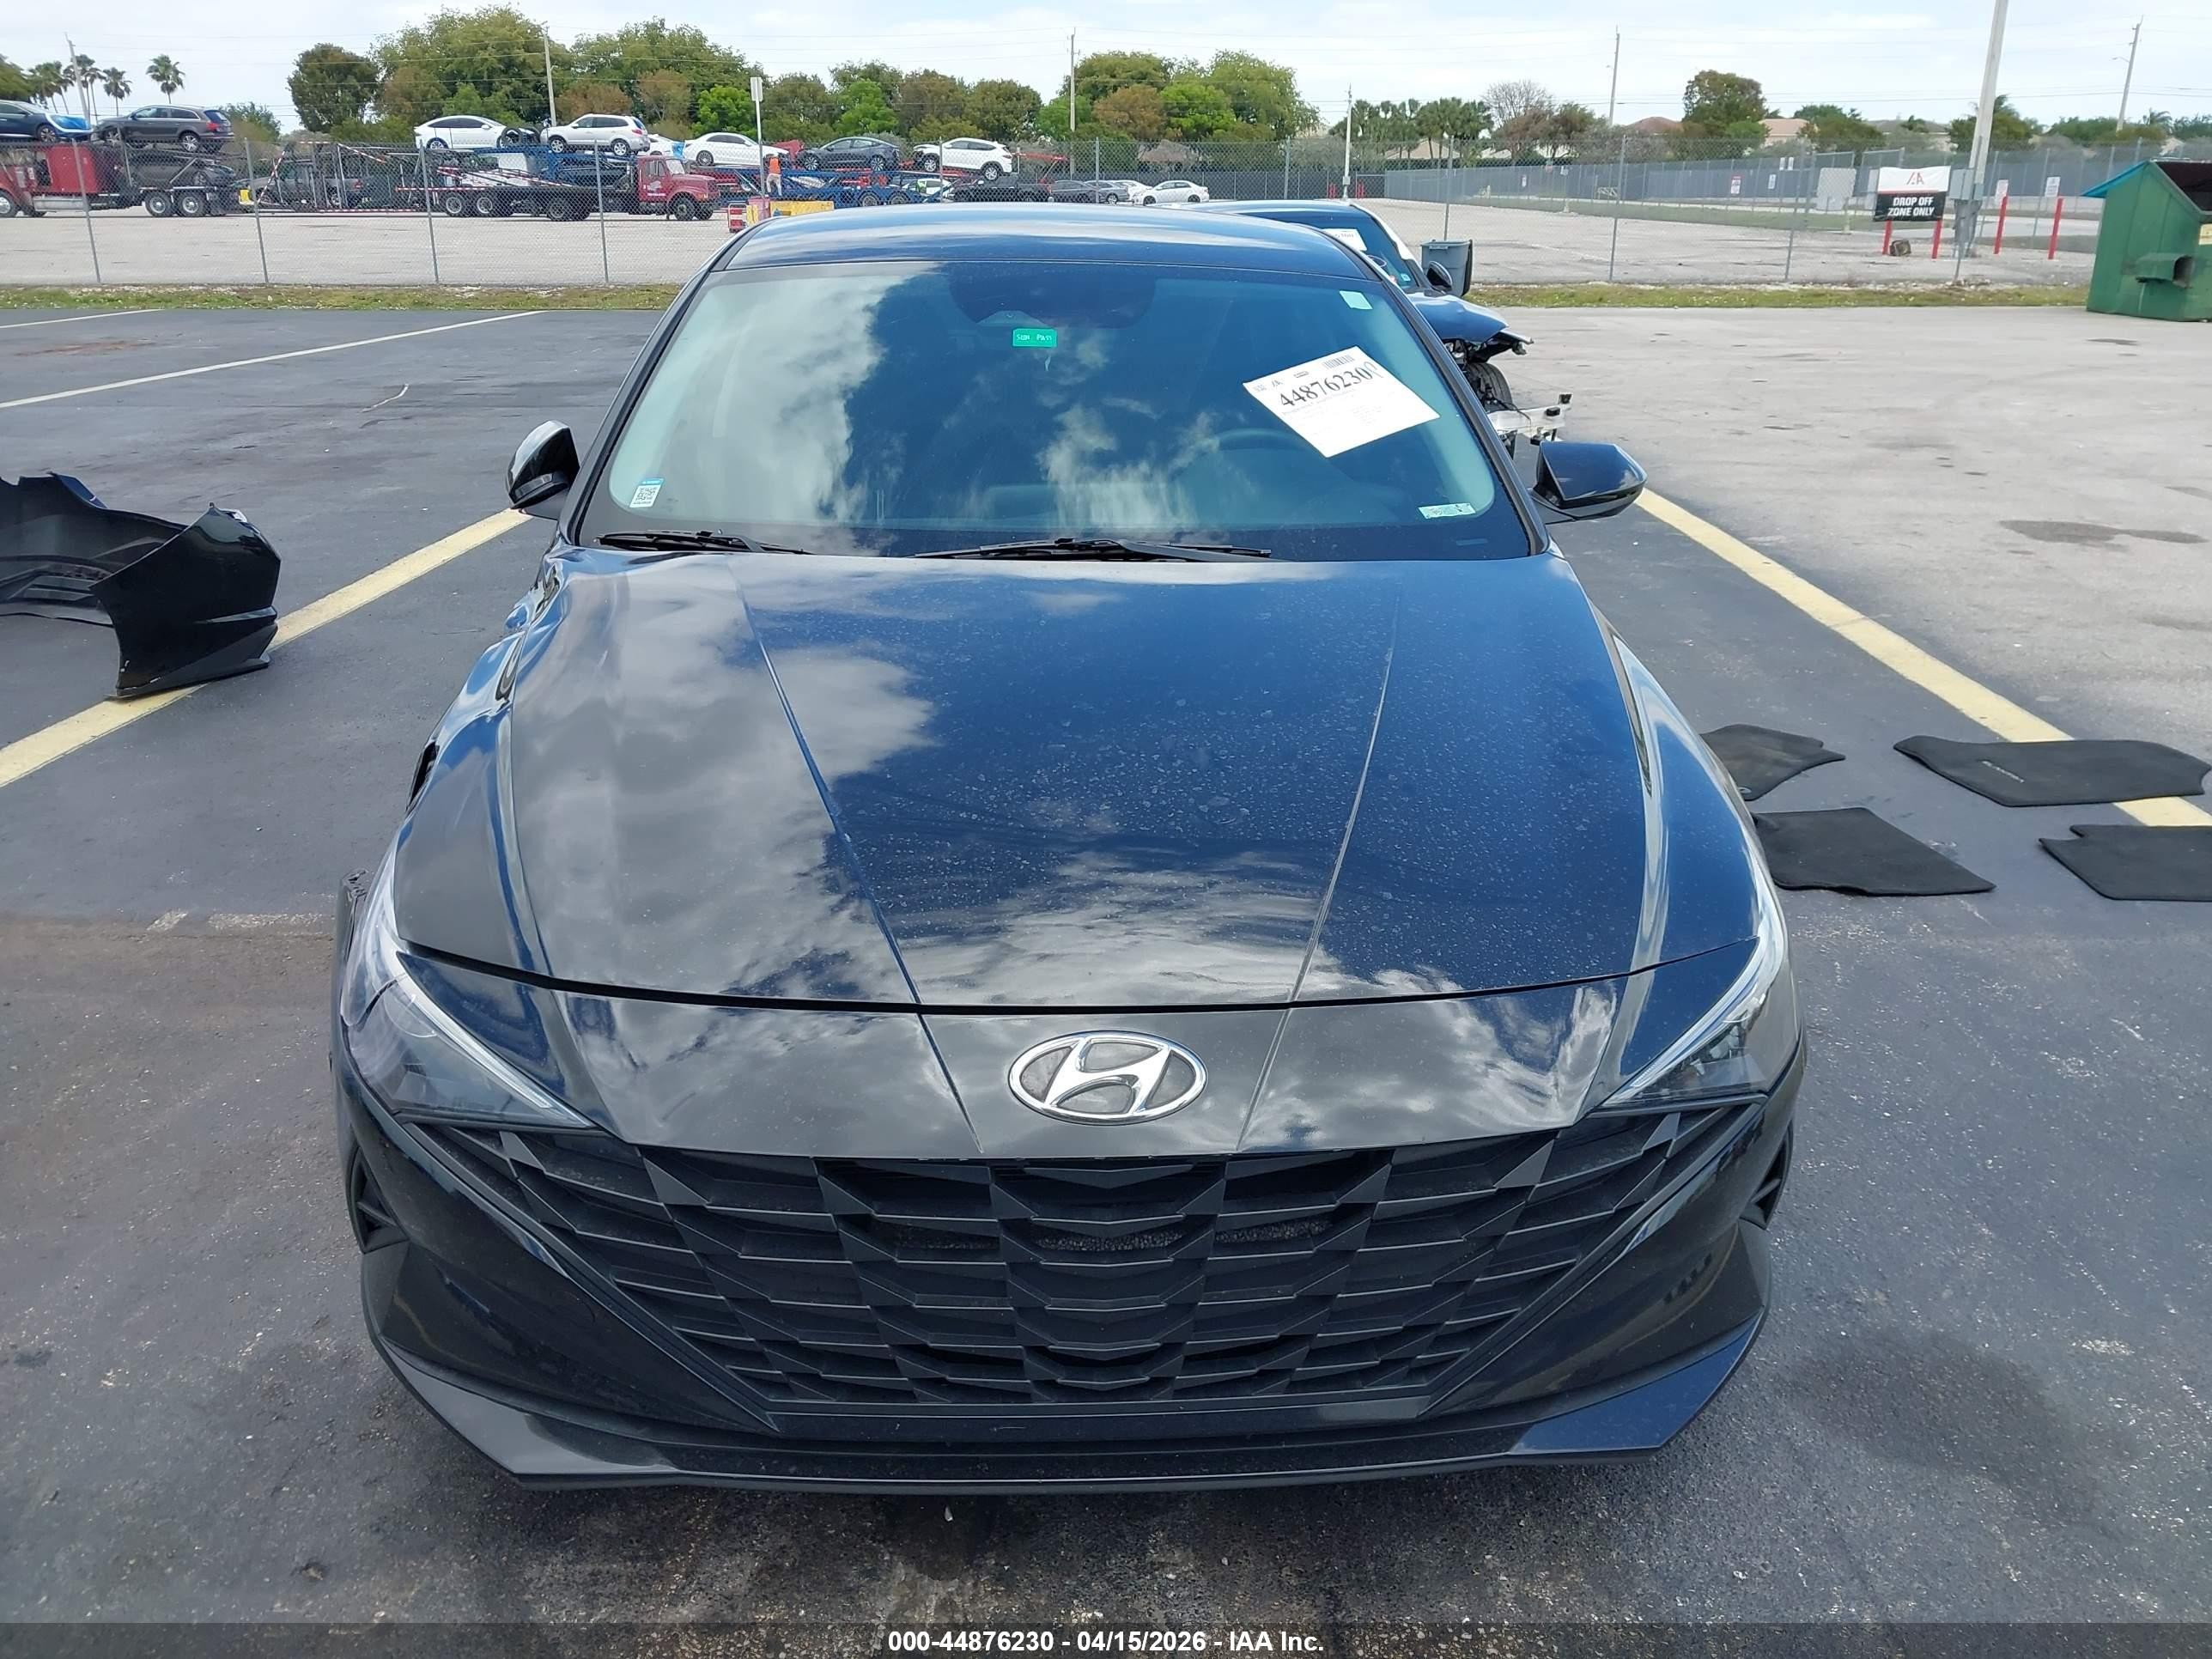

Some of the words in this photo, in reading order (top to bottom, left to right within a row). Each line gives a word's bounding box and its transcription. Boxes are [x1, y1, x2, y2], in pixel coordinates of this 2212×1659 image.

[1893, 197, 1917, 206] DROP
[1918, 196, 1935, 206] OFF
[1887, 207, 1912, 216] ZONE
[1913, 206, 1935, 216] ONLY
